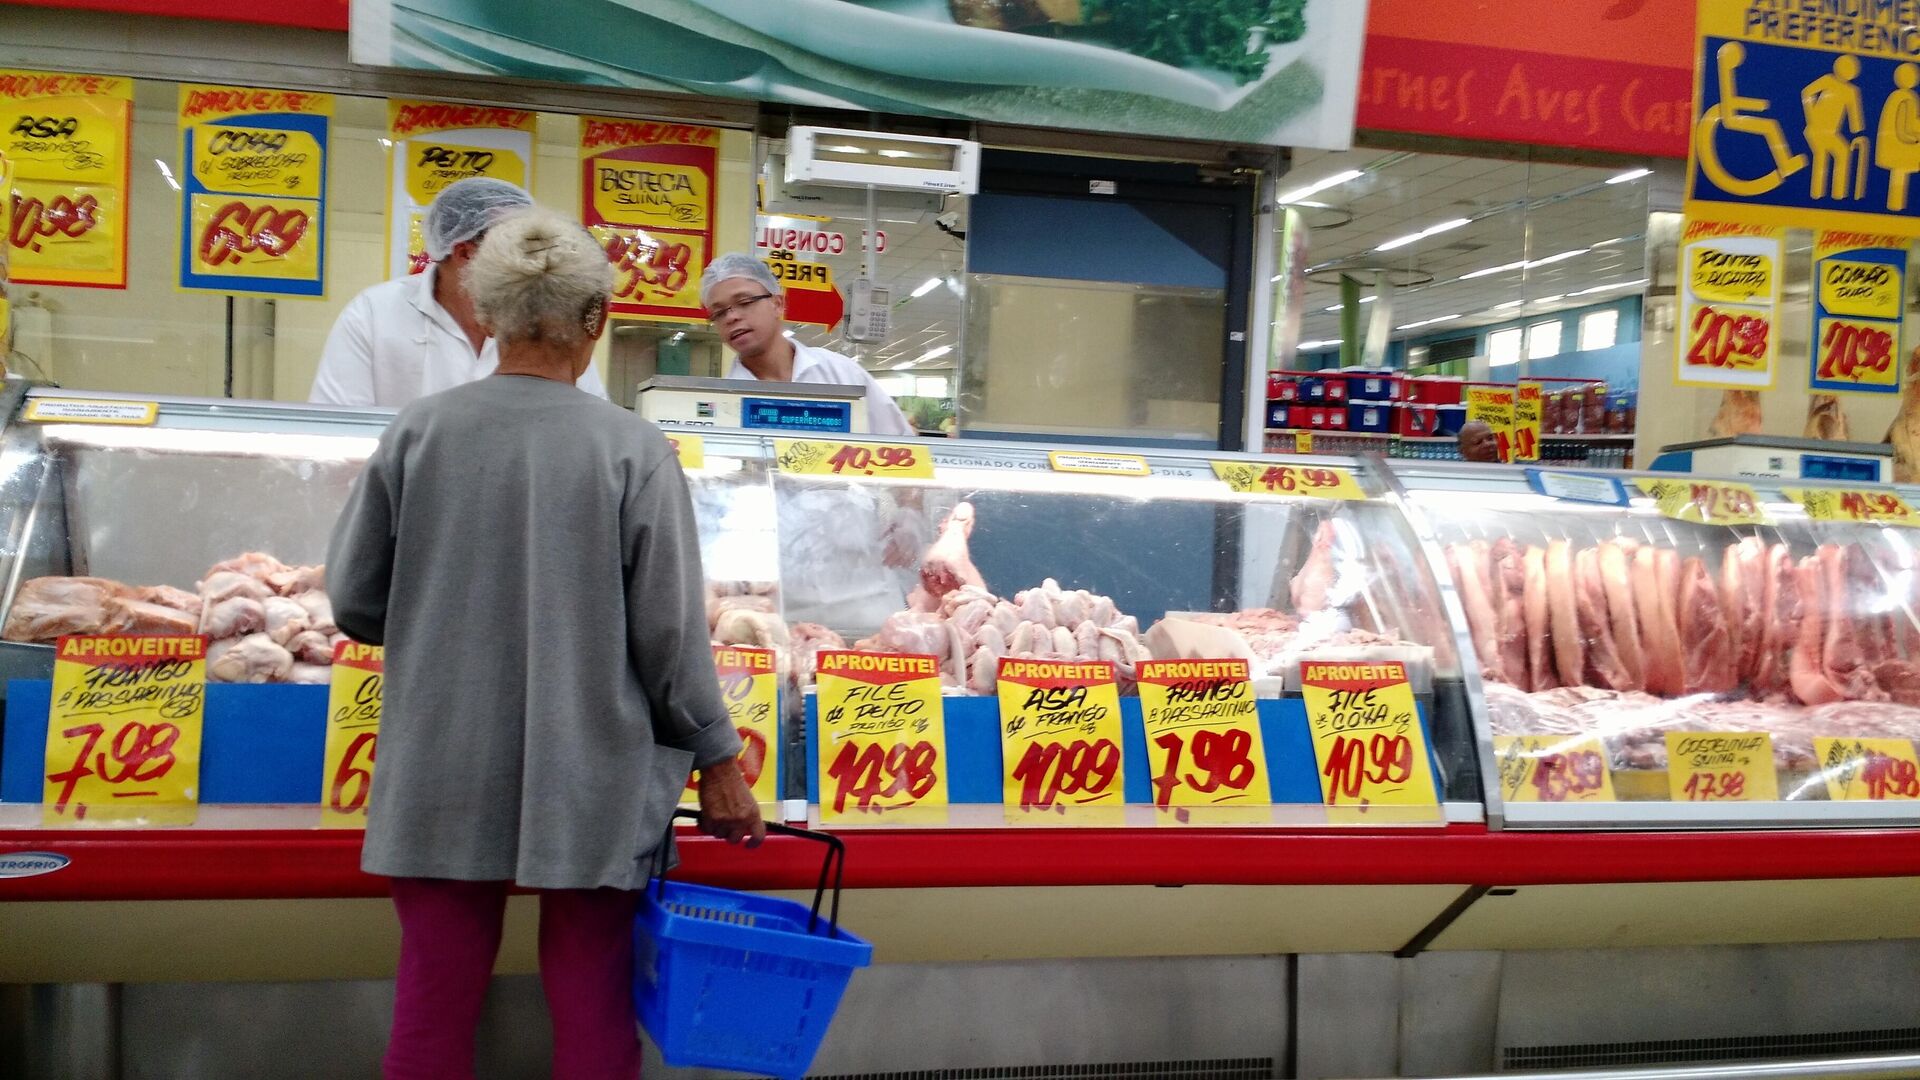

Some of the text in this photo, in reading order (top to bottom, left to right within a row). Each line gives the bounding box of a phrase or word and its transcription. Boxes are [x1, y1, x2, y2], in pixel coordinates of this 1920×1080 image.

[1495, 62, 1606, 136] Aves
[9, 116, 78, 139] ASA
[417, 146, 496, 171] PEITO
[598, 168, 697, 197] BISTECA
[62, 637, 202, 658] APROVEITE!
[85, 659, 193, 690] FRANGO
[823, 655, 935, 674] APROVEITE!
[1001, 662, 1111, 679] APROVEITE!
[1142, 662, 1247, 679] APROVEITE!
[1306, 665, 1404, 681] APROVEITE!
[843, 684, 908, 703] FILE
[1023, 685, 1088, 711] ASA
[1165, 678, 1246, 705] FRANGO
[854, 700, 925, 720] PEITO
[1036, 704, 1107, 726] FRANGO
[1159, 700, 1256, 724] PASSARINHO
[1676, 736, 1763, 756] COSTELINHA
[1012, 738, 1120, 815] 10.99
[1151, 728, 1255, 824] 7.98
[1323, 734, 1413, 813] 10.99
